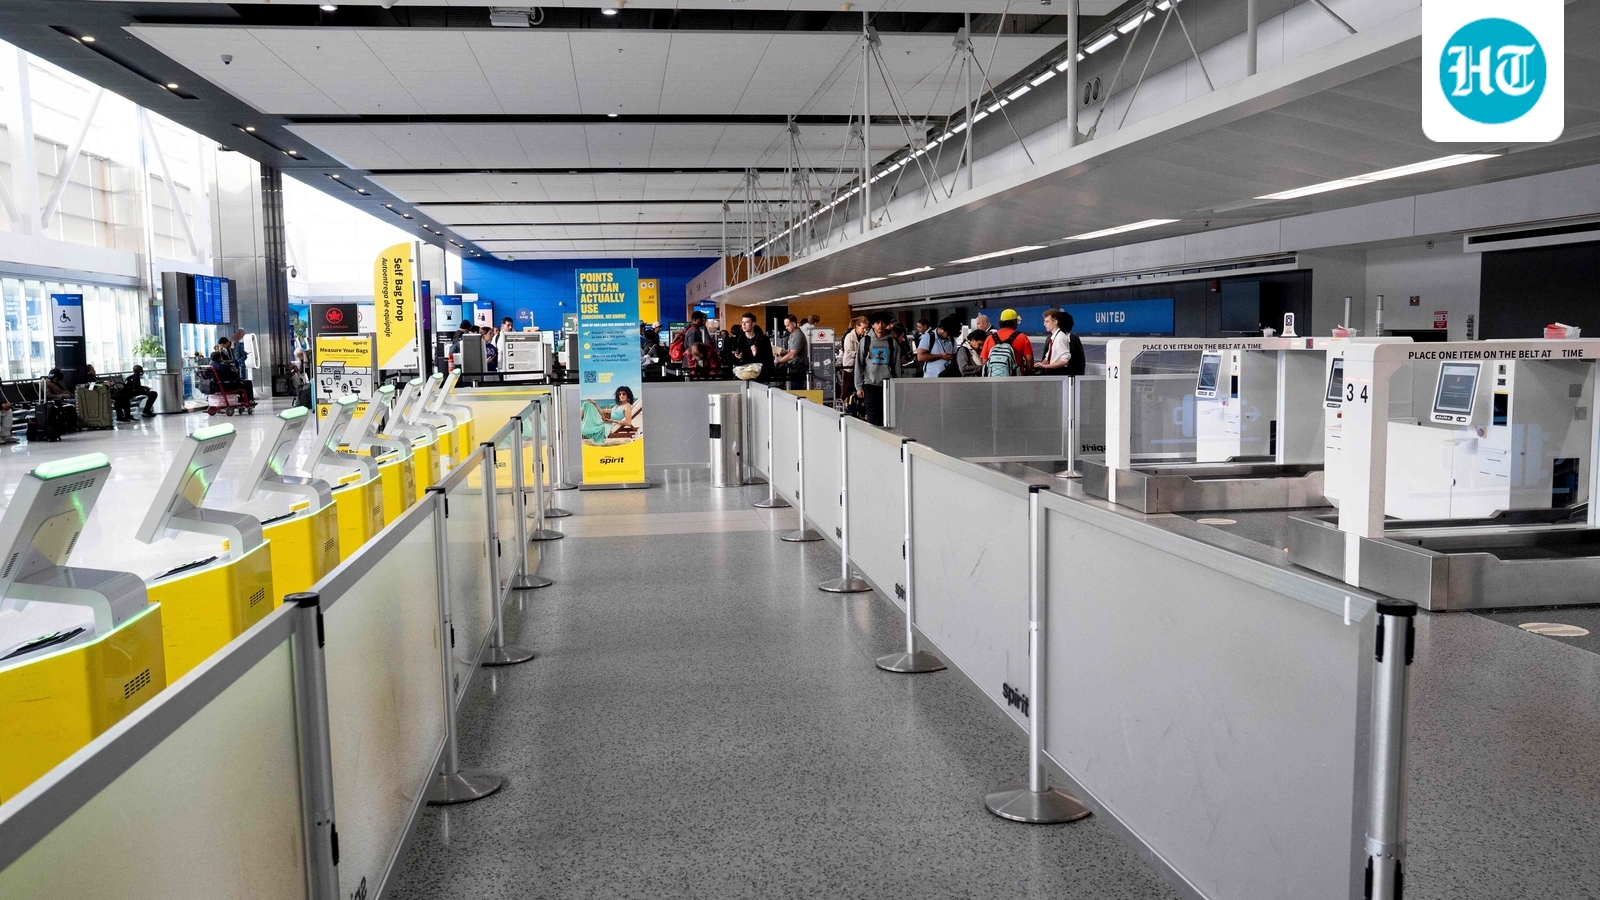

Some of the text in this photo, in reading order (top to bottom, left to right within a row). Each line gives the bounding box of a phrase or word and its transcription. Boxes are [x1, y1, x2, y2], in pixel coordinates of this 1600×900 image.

[580, 272, 614, 282] POINTS
[394, 258, 404, 322] Self Bag Drop
[580, 282, 619, 293] YOU CAN
[580, 293, 625, 303] ACTUALLY
[384, 300, 390, 308] de
[580, 304, 599, 314] USE
[1095, 311, 1126, 323] UNITED
[384, 310, 392, 338] equipaje
[1408, 349, 1583, 360] PLACE ONE ITEM ON THE BELT AT TIME
[1108, 366, 1118, 378] 1 2
[1346, 383, 1368, 404] 3 4
[600, 456, 625, 465] spirit
[1002, 682, 1029, 718] spirit
